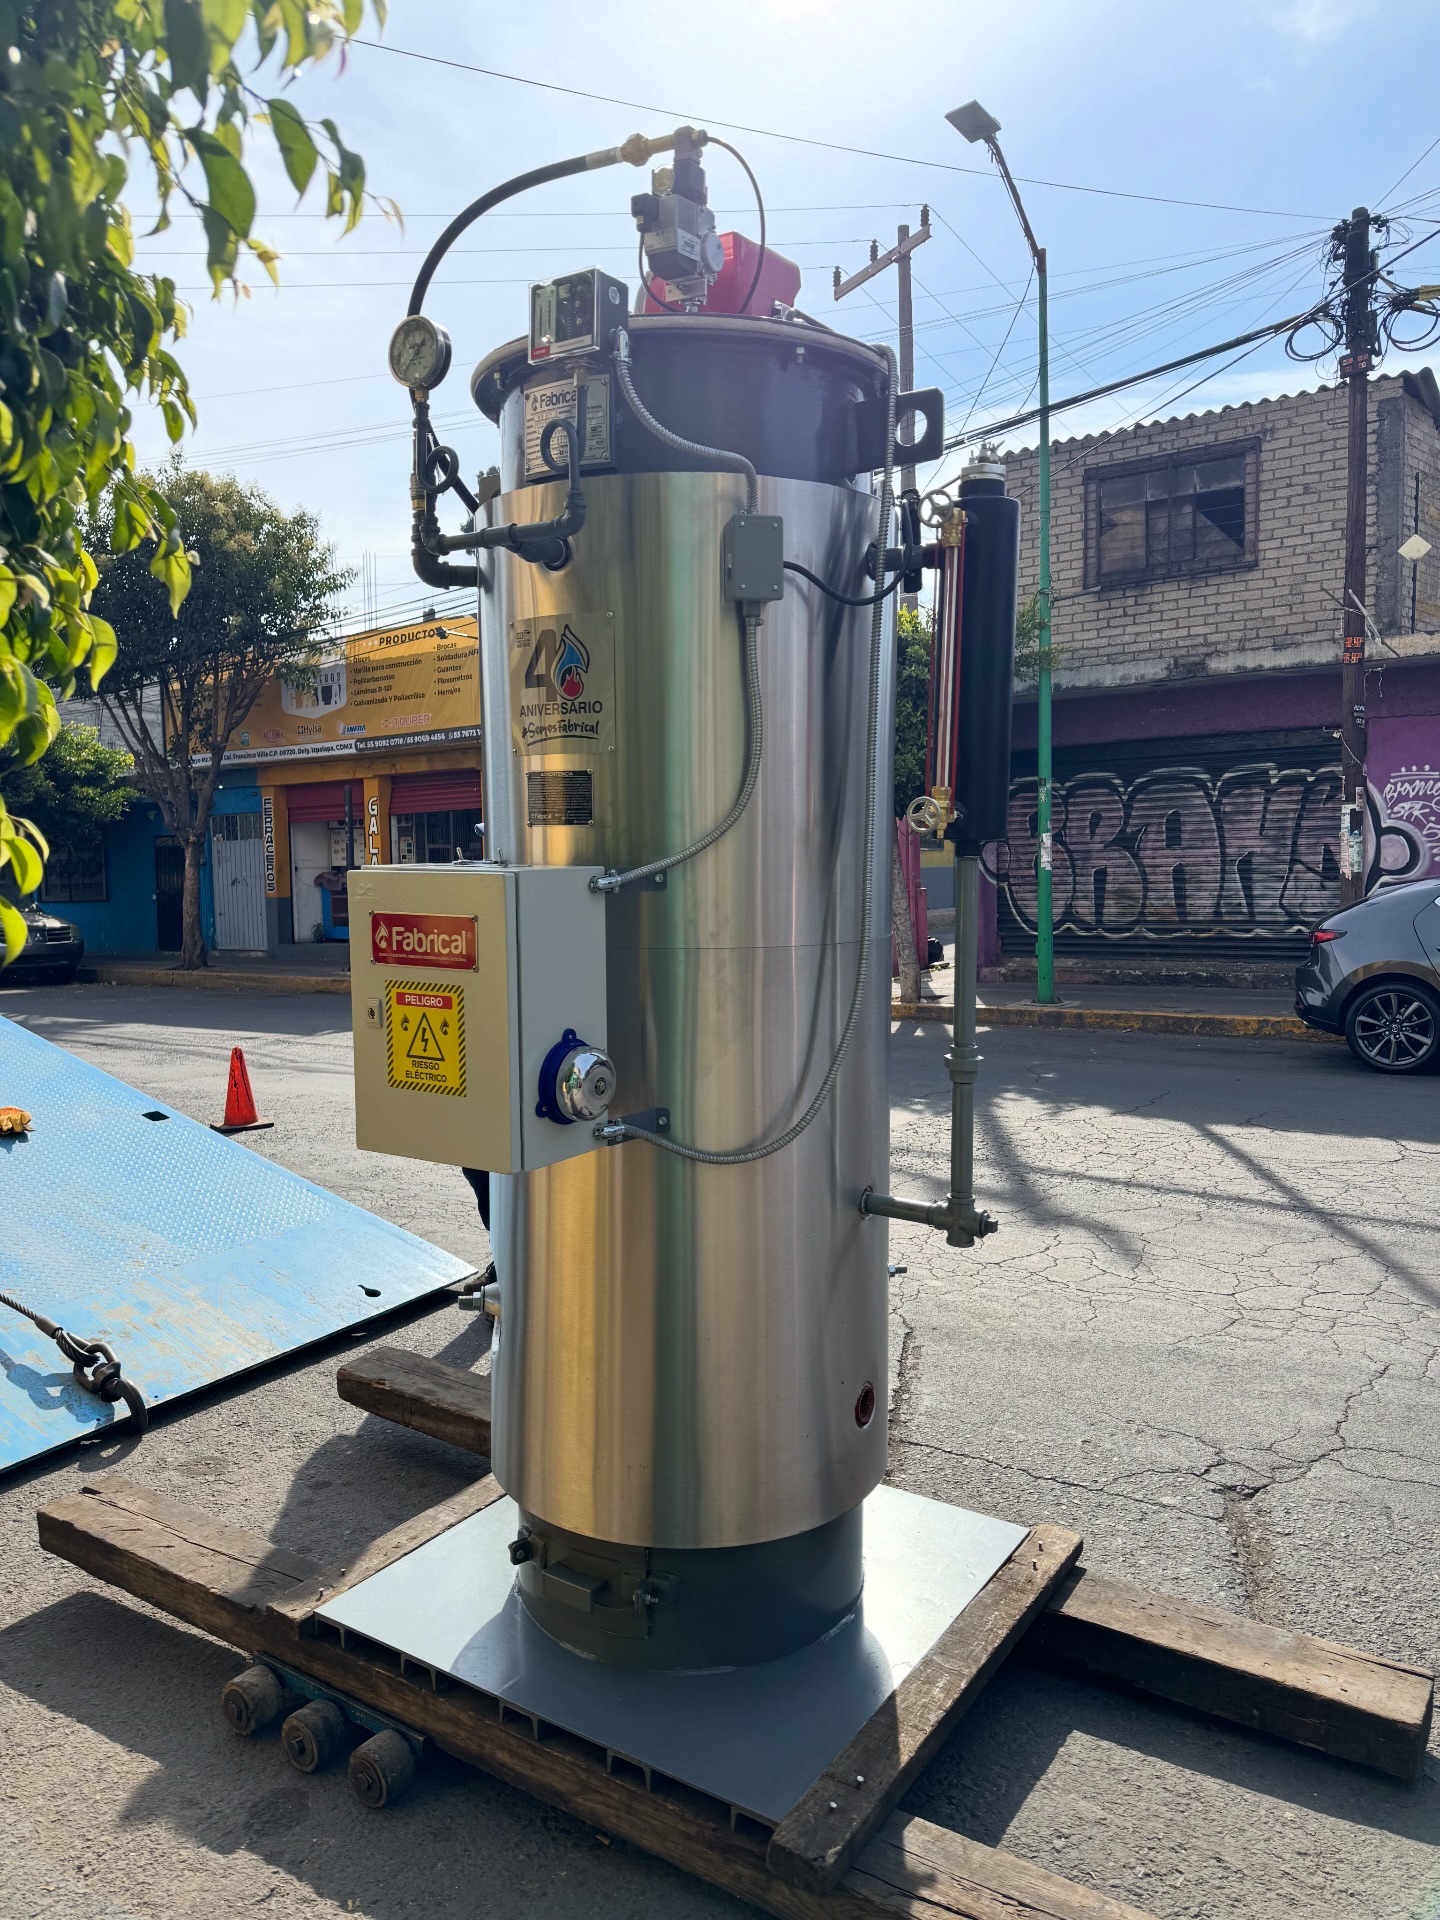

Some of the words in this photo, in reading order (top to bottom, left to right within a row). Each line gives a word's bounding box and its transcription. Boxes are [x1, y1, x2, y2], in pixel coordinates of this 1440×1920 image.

[540, 390, 577, 409] Fabrica
[436, 643, 457, 651] Brocas
[436, 652, 468, 662] Soldadura
[371, 664, 385, 673] para
[385, 658, 423, 670] construcción
[436, 664, 462, 673] Guantes
[353, 674, 395, 685] Policarbonatos
[437, 687, 461, 697] Herrajes
[354, 697, 388, 707] Galvanizada
[519, 701, 603, 718] ANIVERSARIO
[393, 714, 430, 728] TRUPER
[303, 724, 322, 735] Hylsa
[522, 719, 600, 739] #SomosFabrical
[232, 752, 257, 760] Francisco
[335, 743, 354, 751] CDMX
[262, 796, 276, 893] FERRACEROS
[391, 926, 467, 955] Fabrical
[405, 994, 443, 1007] PELIGRO
[411, 1059, 440, 1071] RIESGO
[405, 1069, 447, 1083] ELÉCTRICO
